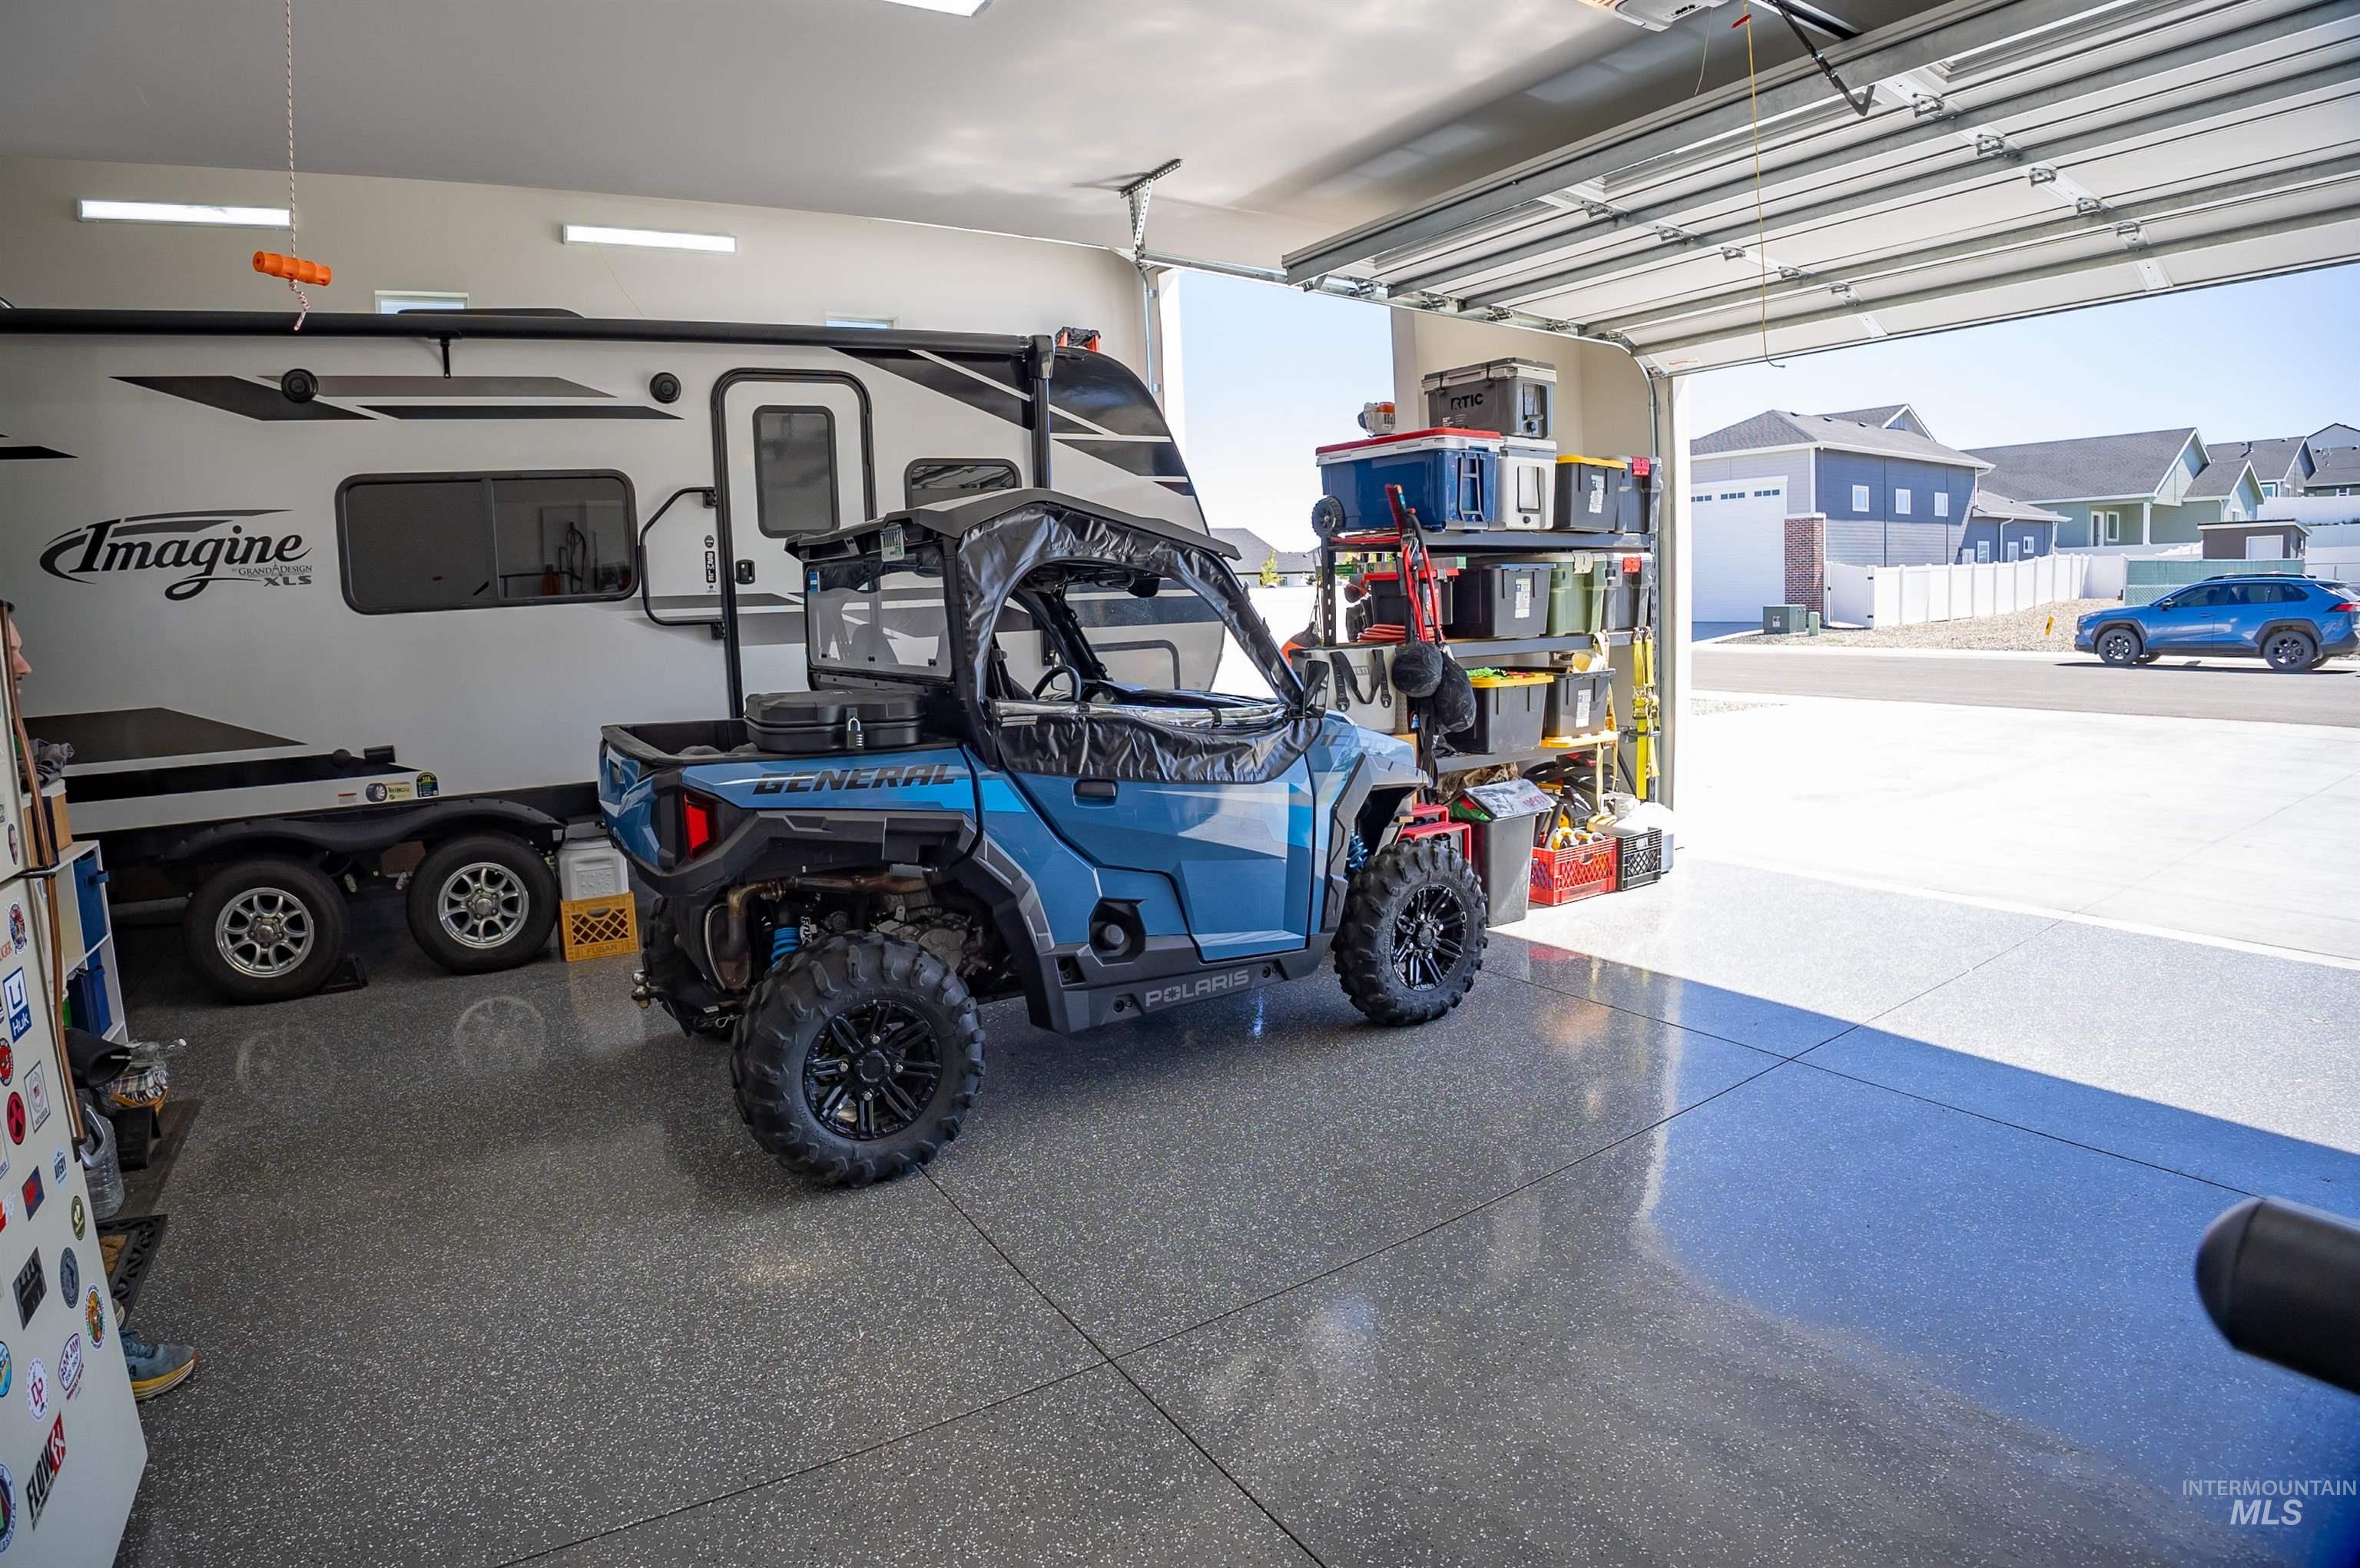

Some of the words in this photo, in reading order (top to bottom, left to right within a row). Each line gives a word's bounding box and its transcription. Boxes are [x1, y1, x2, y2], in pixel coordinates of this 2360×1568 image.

[1450, 393, 1483, 410] RTIC
[68, 518, 313, 601] Imagine
[238, 567, 272, 575] GRAND
[264, 575, 312, 586] XLS
[752, 764, 956, 794] GENERAL
[1145, 969, 1250, 1007] POLARIS
